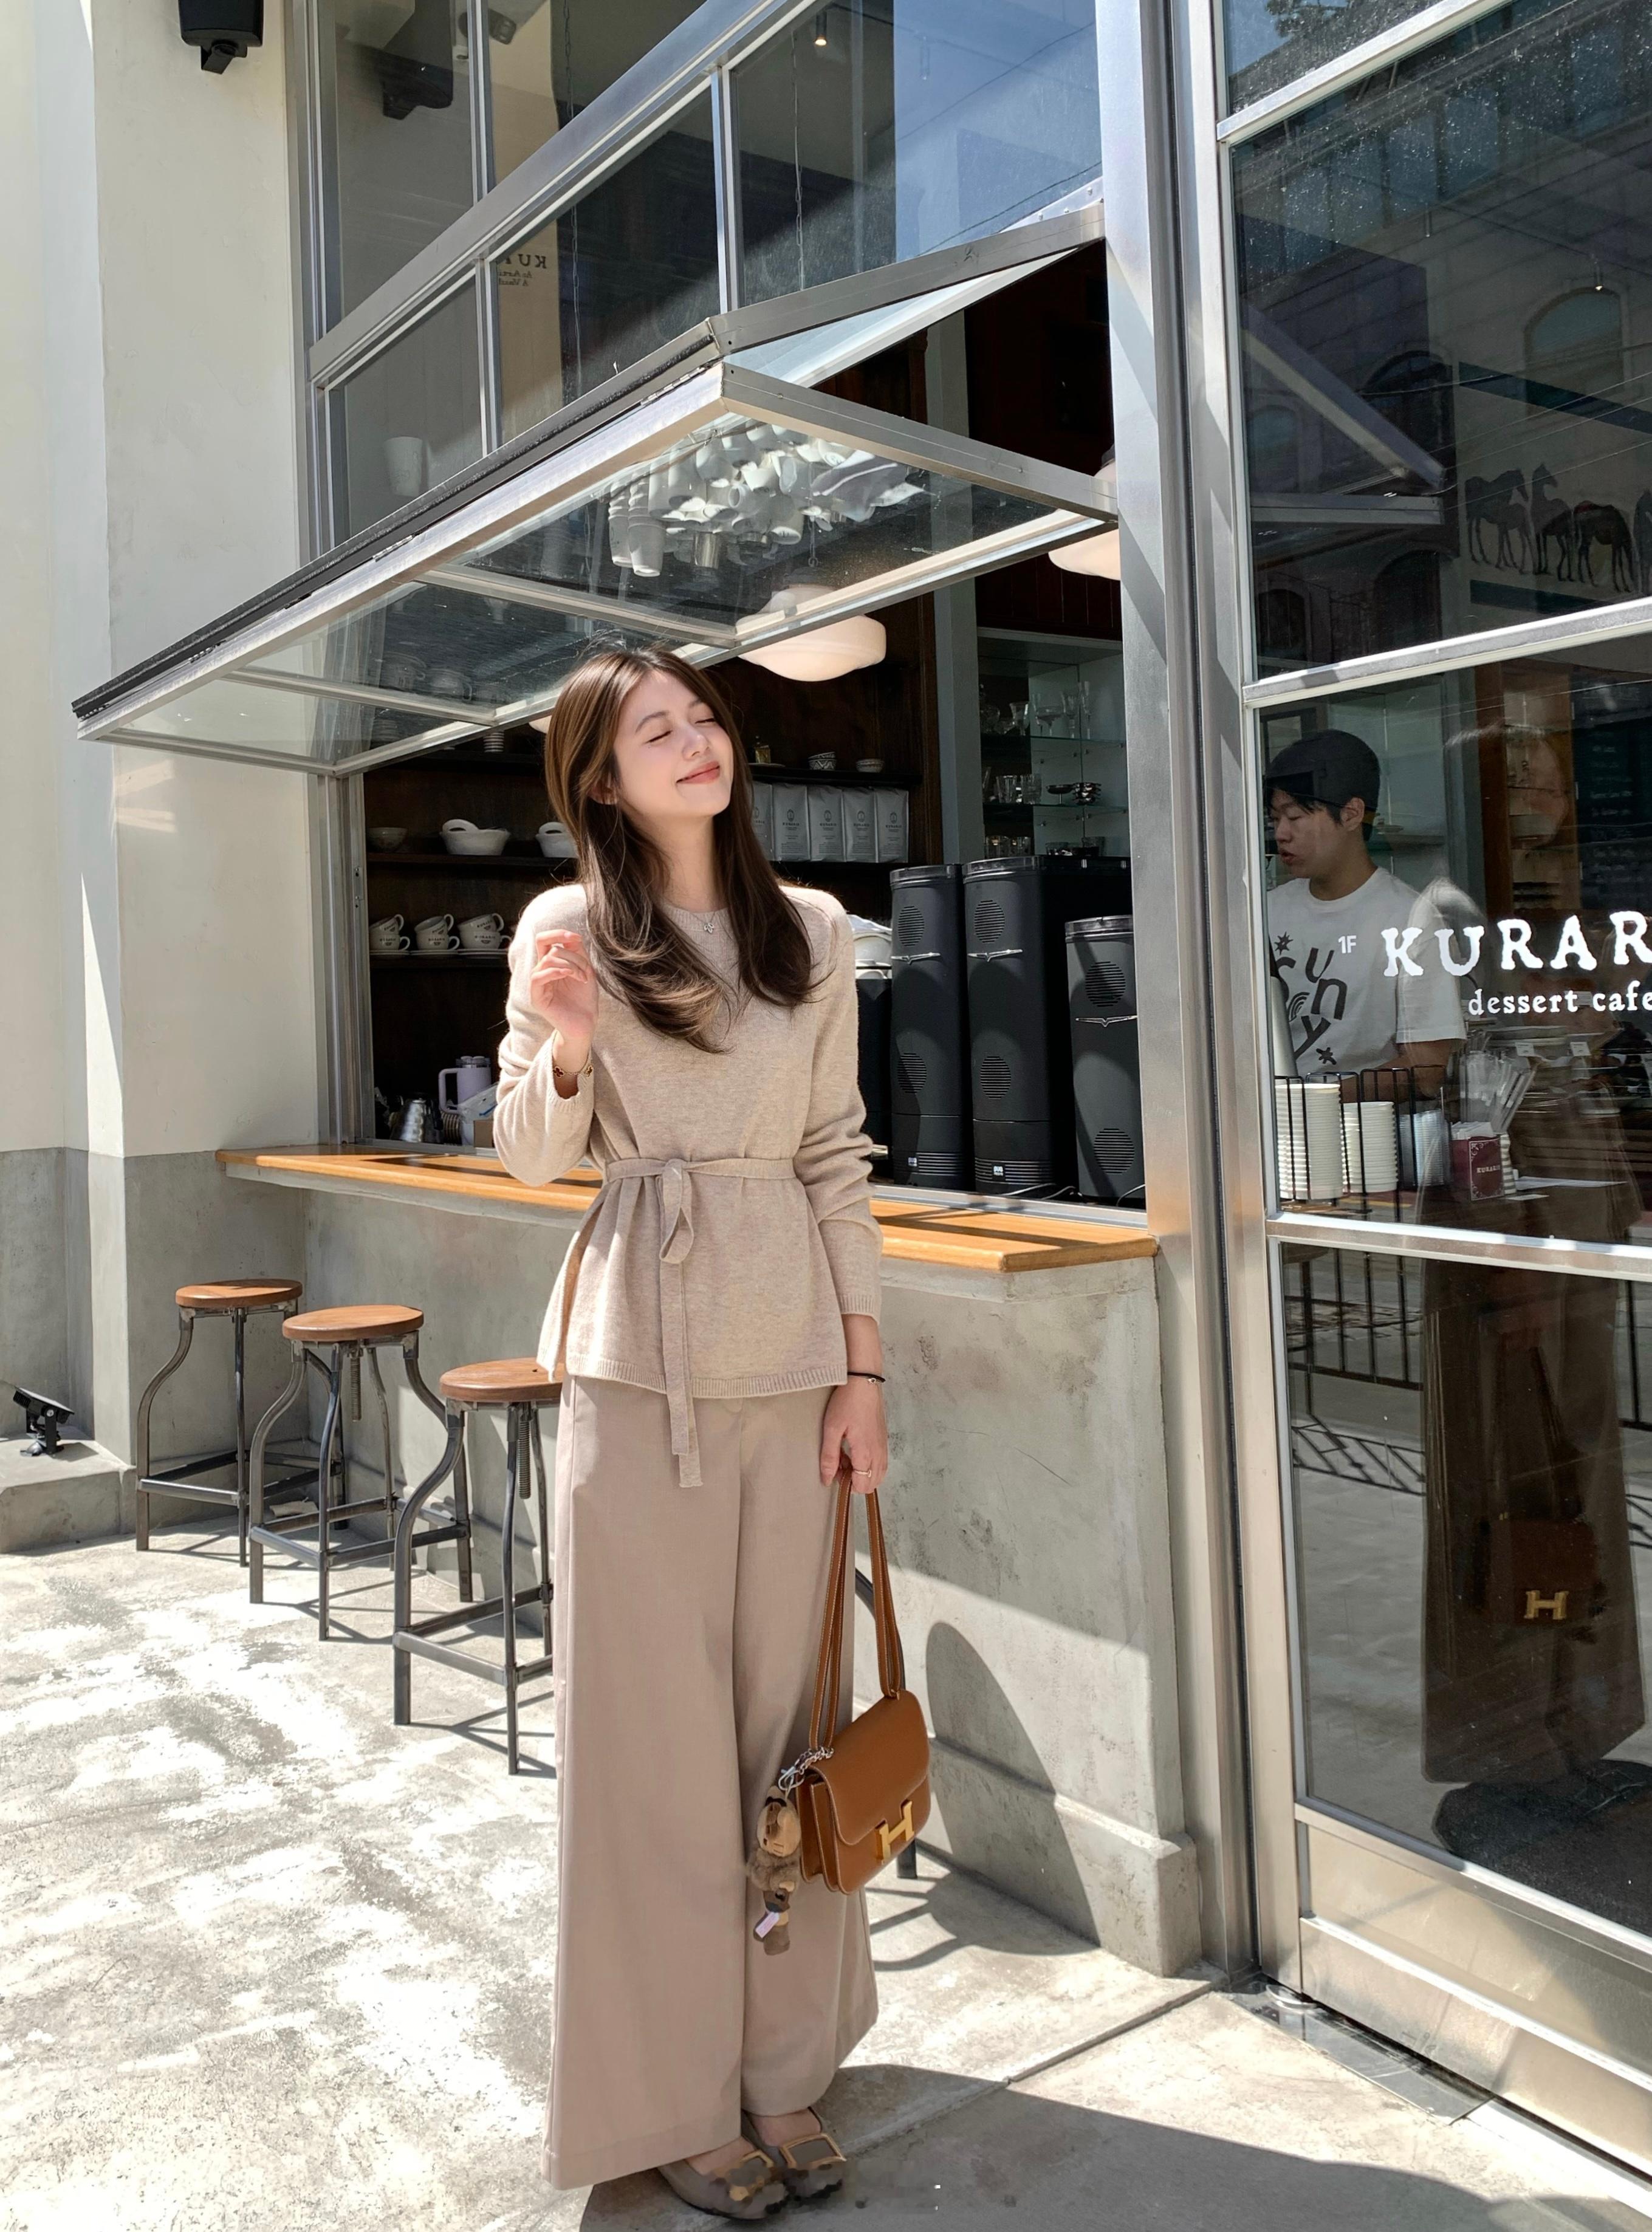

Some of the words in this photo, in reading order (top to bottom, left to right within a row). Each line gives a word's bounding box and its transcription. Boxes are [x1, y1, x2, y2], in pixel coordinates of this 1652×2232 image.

[1338, 935, 1357, 954] 1F
[1381, 911, 1652, 976] KURAR
[1468, 988, 1578, 1016] dessert
[1592, 980, 1652, 1012] cafe
